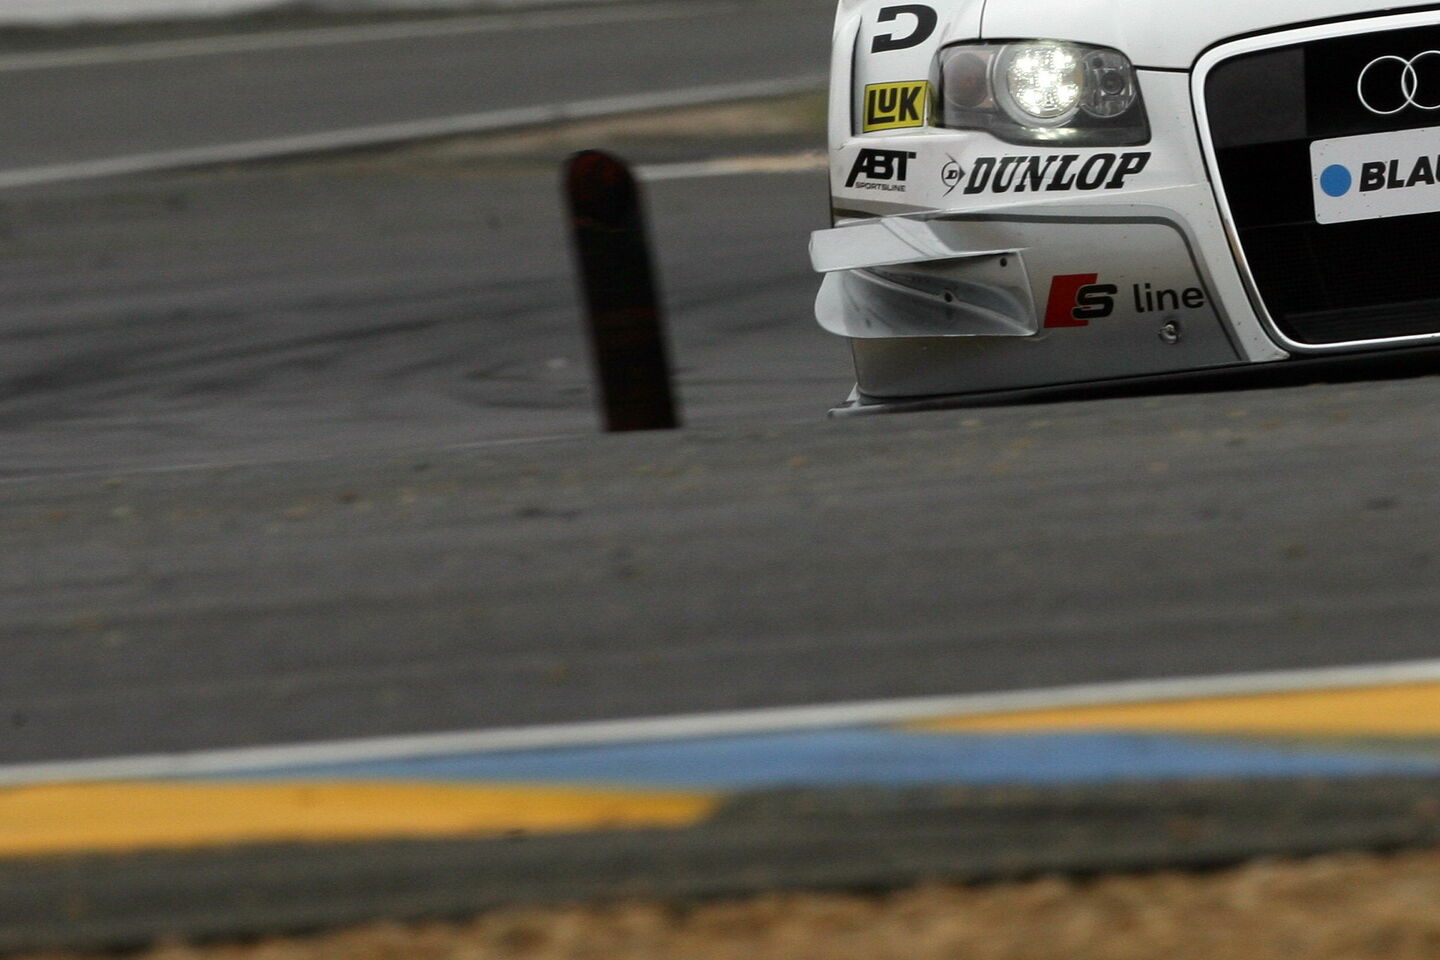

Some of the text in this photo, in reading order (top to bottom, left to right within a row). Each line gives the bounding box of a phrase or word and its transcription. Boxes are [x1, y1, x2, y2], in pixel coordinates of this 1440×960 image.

[845, 148, 917, 188] ABT
[855, 182, 906, 192] SPORTSLINE
[963, 152, 1152, 195] DUNLOP
[1073, 283, 1205, 319] S line
